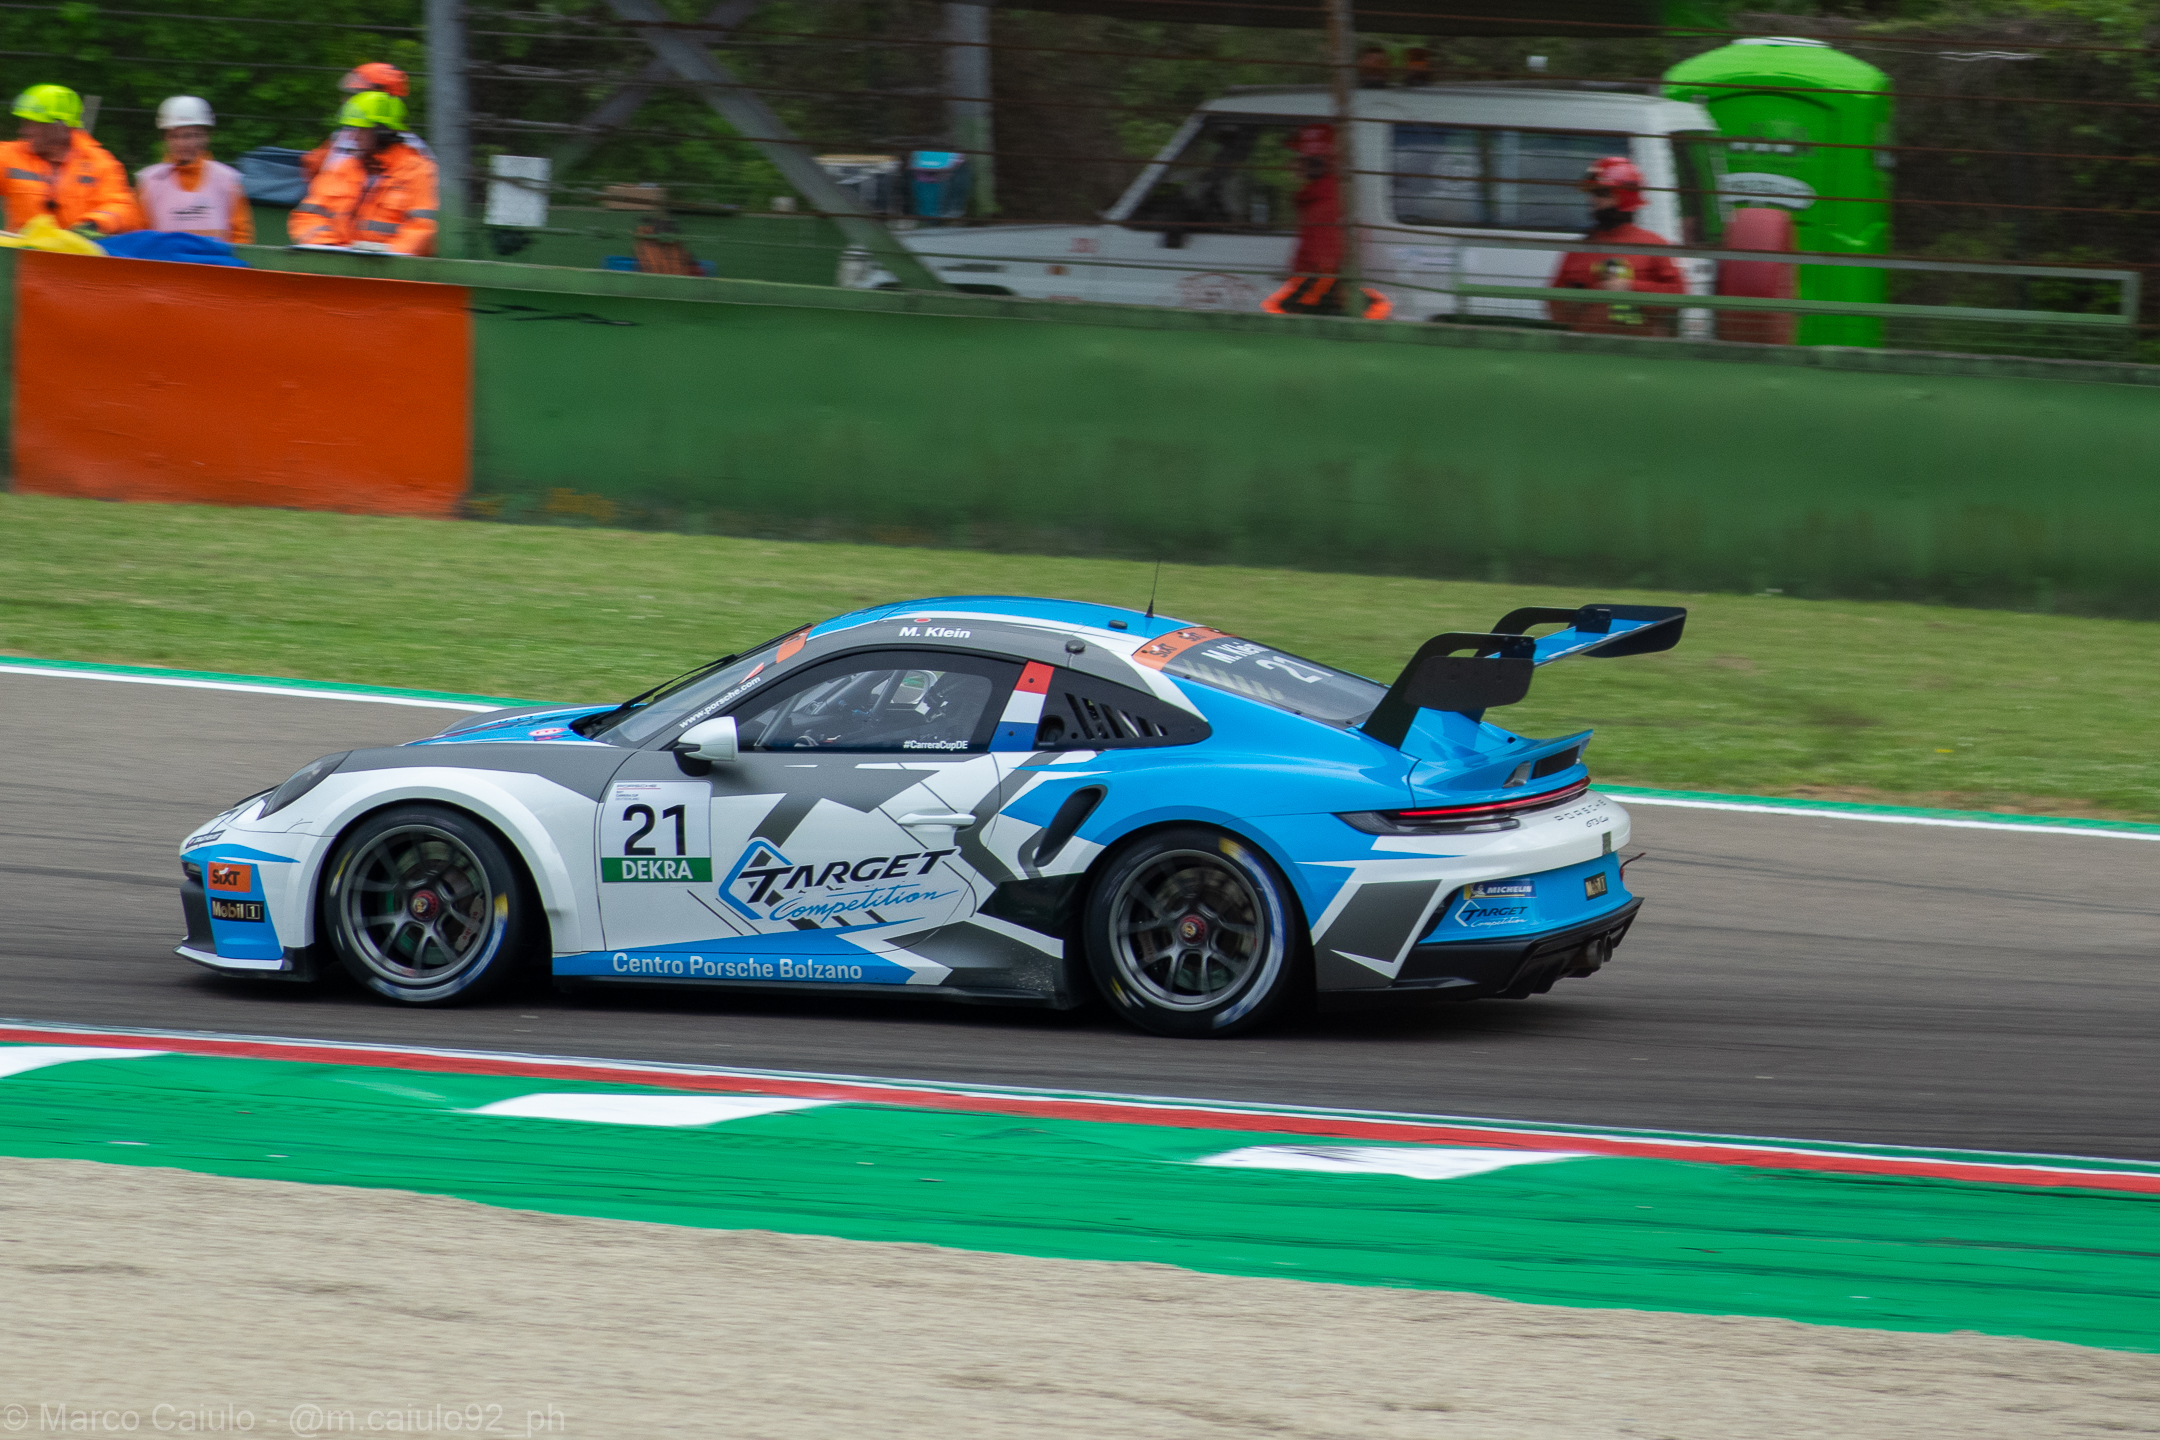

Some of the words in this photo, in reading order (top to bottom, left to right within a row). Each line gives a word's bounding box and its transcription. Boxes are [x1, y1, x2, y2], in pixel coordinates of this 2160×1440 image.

[899, 626, 921, 637] M.
[924, 627, 972, 639] Klein
[1255, 655, 1334, 684] 21
[679, 676, 762, 728] www.porsche.com
[903, 739, 969, 752] #CarreraCupDE
[622, 803, 687, 856] 21
[621, 860, 694, 880] DEKRA
[737, 848, 957, 905] TARGET
[1486, 885, 1533, 895] MICHELIN
[212, 900, 244, 919] Mobil
[248, 904, 257, 919] 1
[769, 883, 959, 924] Competition
[1462, 906, 1529, 922] TARGET
[613, 952, 684, 975] Centro
[689, 955, 774, 978] Porsche
[779, 958, 863, 980] Bolzano
